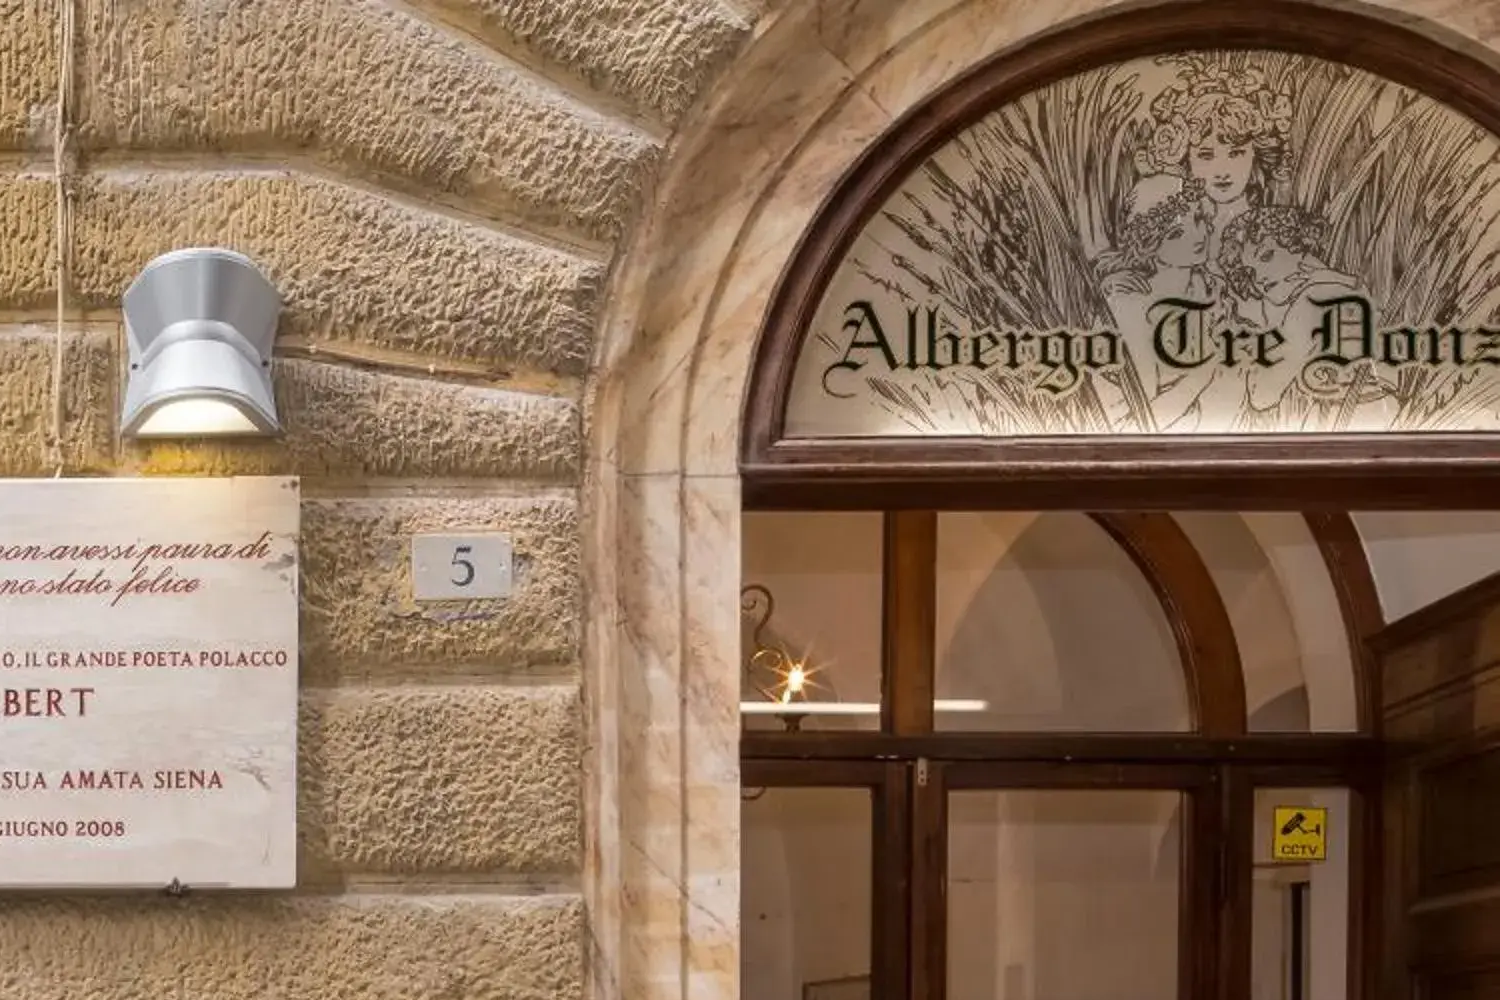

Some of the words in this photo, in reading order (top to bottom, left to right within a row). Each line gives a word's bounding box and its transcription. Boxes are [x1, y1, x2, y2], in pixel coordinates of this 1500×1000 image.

[821, 300, 1121, 398] Albergo
[1147, 297, 1286, 369] Tre
[42, 538, 138, 561] avessi
[132, 541, 234, 573] paura
[231, 530, 272, 560] di
[451, 546, 475, 587] 5
[35, 568, 112, 595] stato
[110, 565, 200, 608] felice
[25, 651, 41, 668] IL
[46, 651, 127, 668] GRANDE
[132, 651, 194, 667] POETA
[199, 650, 289, 668] POLACCO
[1, 771, 48, 790] SUA
[60, 771, 145, 790] AMATA
[153, 770, 224, 790] SIENA
[75, 821, 126, 837] 2008
[1282, 844, 1318, 856] CCTV
